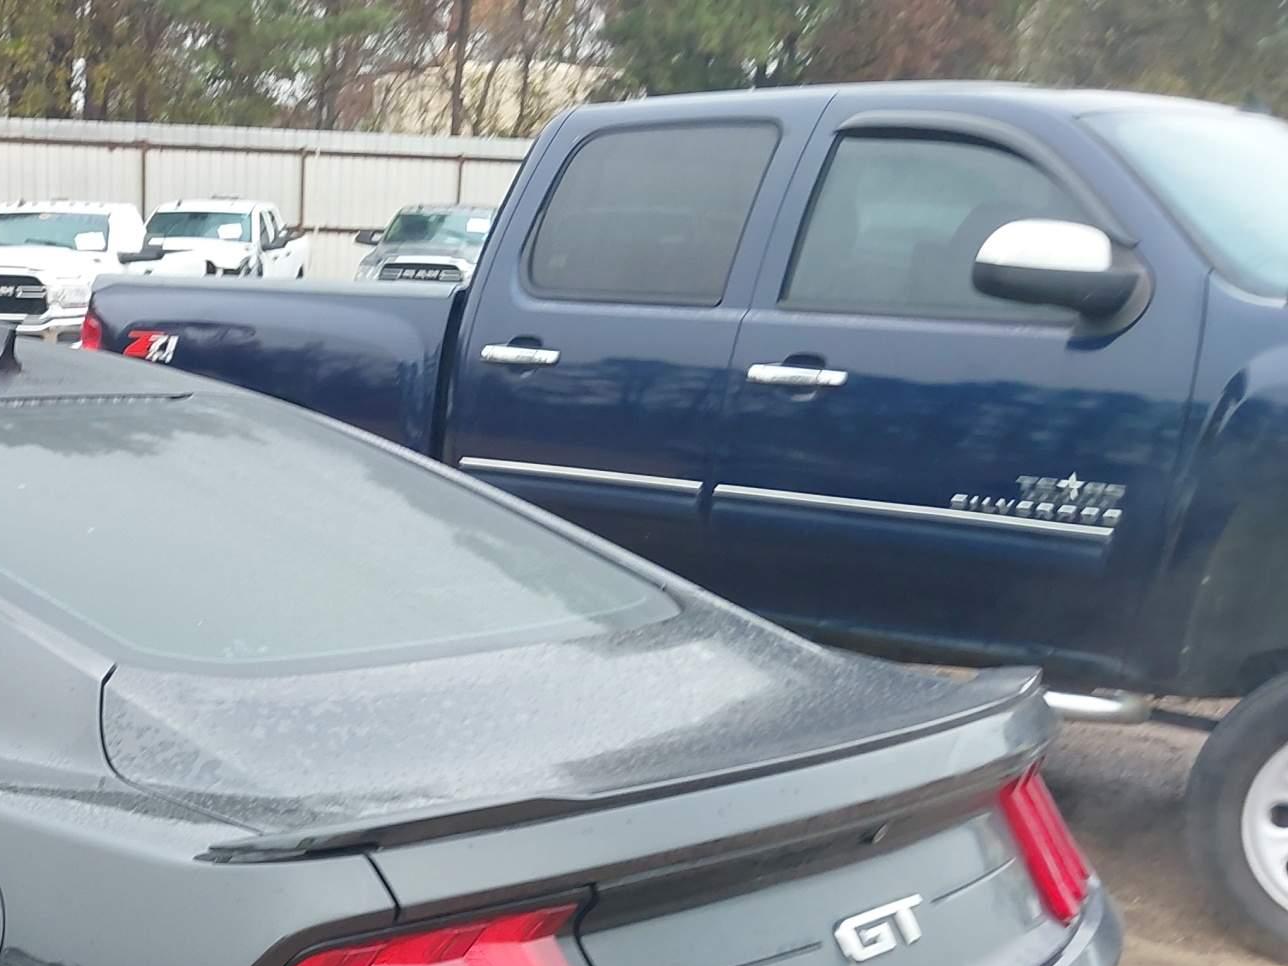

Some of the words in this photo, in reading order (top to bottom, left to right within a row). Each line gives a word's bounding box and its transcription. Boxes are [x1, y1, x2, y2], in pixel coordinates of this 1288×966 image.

[122, 330, 180, 363] Z71
[951, 494, 1123, 526] SILVERADO
[833, 893, 923, 962] GT
